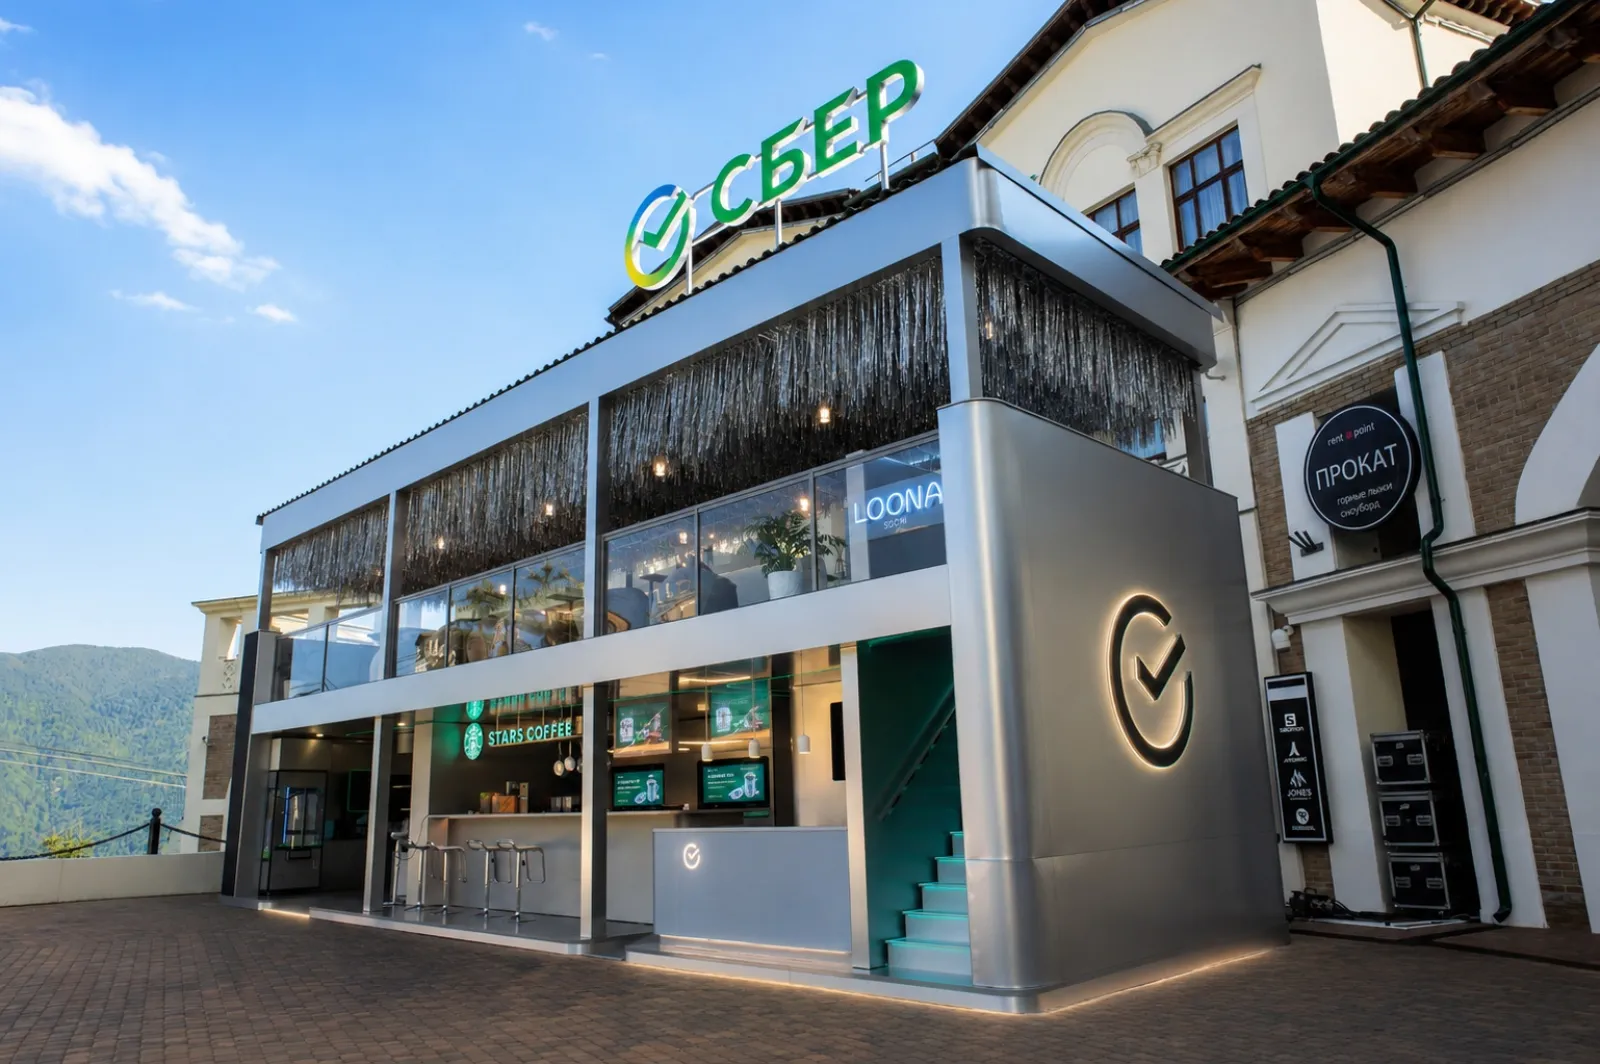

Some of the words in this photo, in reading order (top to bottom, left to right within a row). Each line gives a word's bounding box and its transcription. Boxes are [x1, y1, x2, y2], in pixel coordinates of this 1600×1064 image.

[711, 59, 922, 225] СБЕР
[1328, 434, 1344, 446] rent
[1353, 422, 1375, 439] point
[1315, 443, 1397, 490] ПРОКАТ
[853, 480, 943, 524] LOONA
[1337, 490, 1366, 506] горные
[1367, 482, 1393, 498] лыжи
[1340, 500, 1381, 518] сноуборд
[488, 727, 523, 747] STARS
[526, 721, 572, 741] COFFEE
